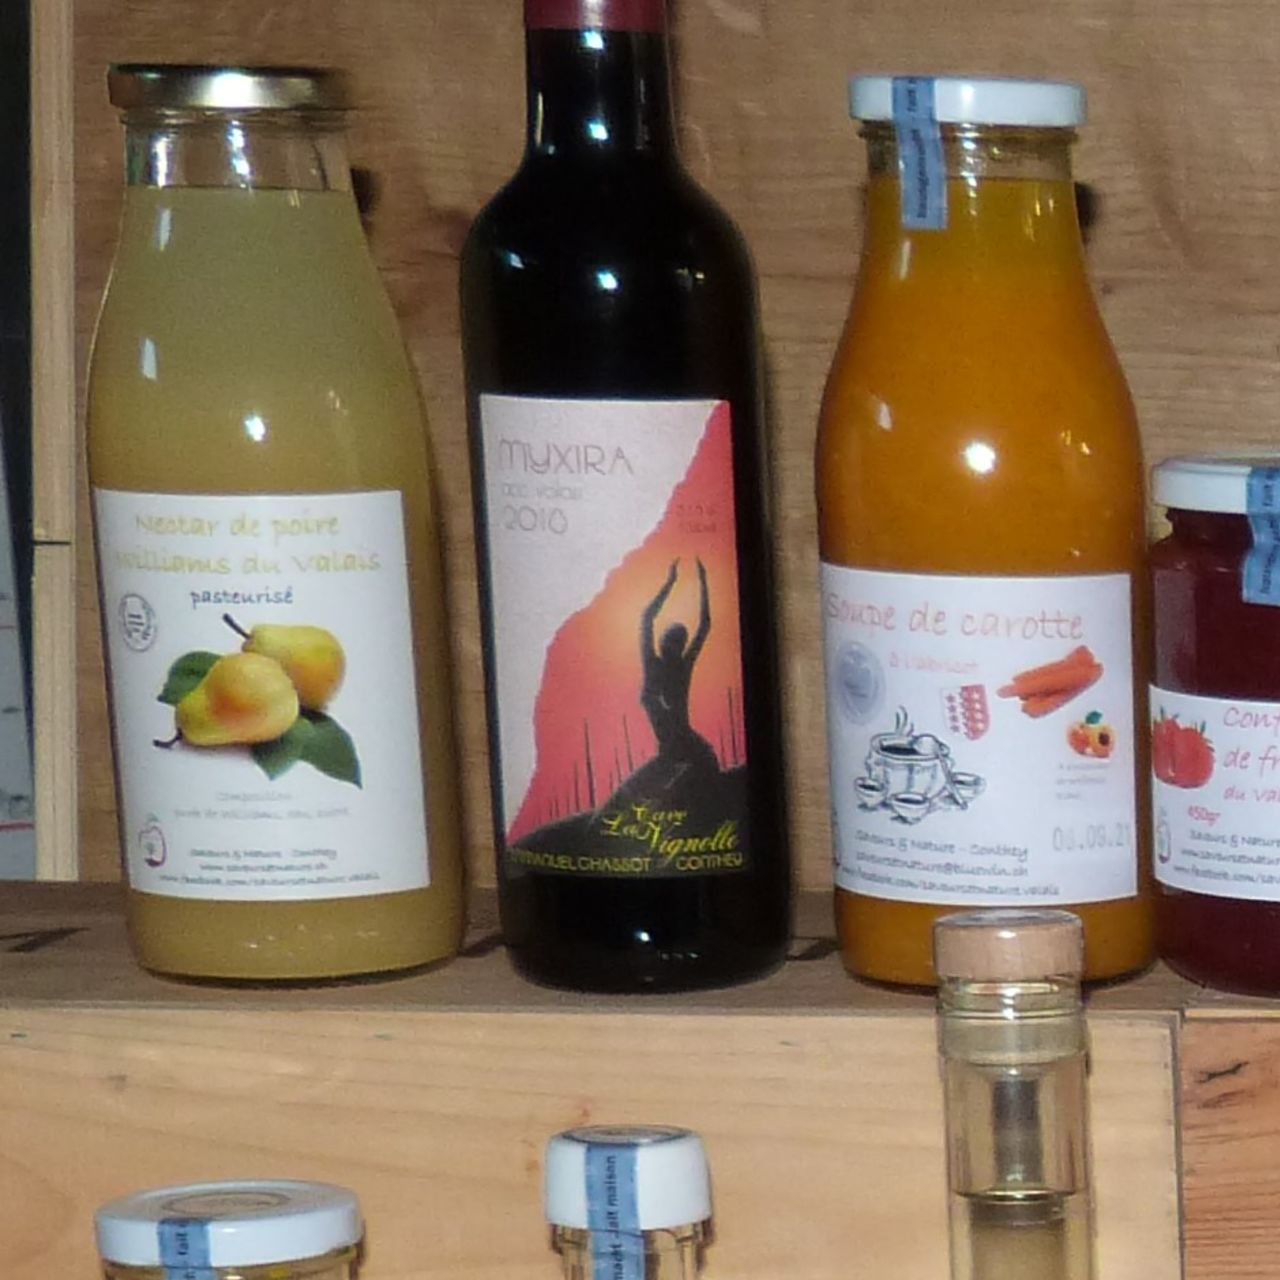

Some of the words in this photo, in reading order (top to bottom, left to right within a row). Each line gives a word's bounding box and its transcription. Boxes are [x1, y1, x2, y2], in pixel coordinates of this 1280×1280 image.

[190, 587, 294, 607] pasteurisé
[909, 602, 947, 634] de
[960, 610, 1083, 640] carotte
[1223, 747, 1252, 770] de
[1223, 784, 1249, 802] du
[604, 1155, 618, 1207] maison
